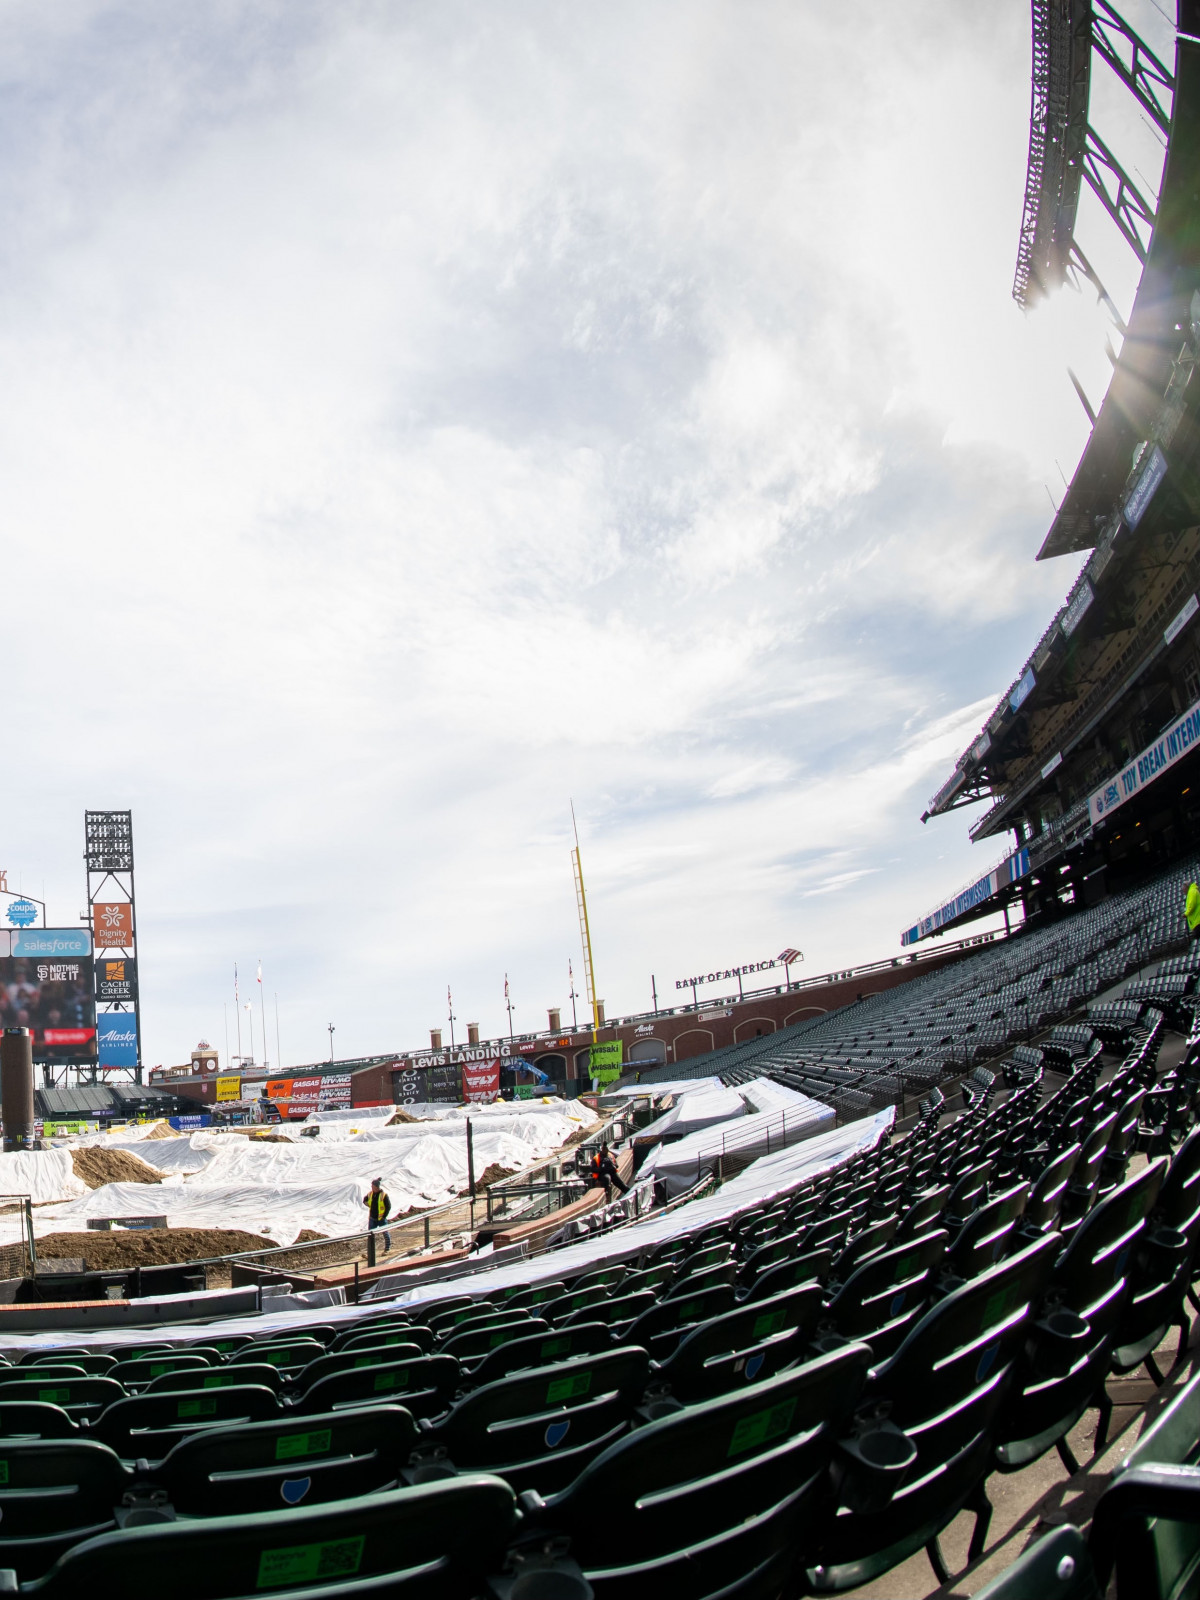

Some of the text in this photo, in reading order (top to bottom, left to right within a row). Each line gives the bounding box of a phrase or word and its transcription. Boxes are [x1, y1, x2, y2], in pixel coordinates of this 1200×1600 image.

[1121, 766, 1137, 795] TOY
[1138, 741, 1167, 783] BREAK
[10, 904, 36, 915] coupa
[99, 929, 127, 939] Dignity
[23, 940, 82, 953] salesforce
[49, 964, 79, 973] NOTHING
[675, 959, 776, 989] BANK OF AMERICA
[49, 971, 79, 981] LIKE IT
[99, 1029, 137, 1041] Alaska
[449, 1045, 511, 1063] LANDING
[292, 1079, 320, 1088] GASGAS
[287, 1106, 316, 1114] GASGAS
